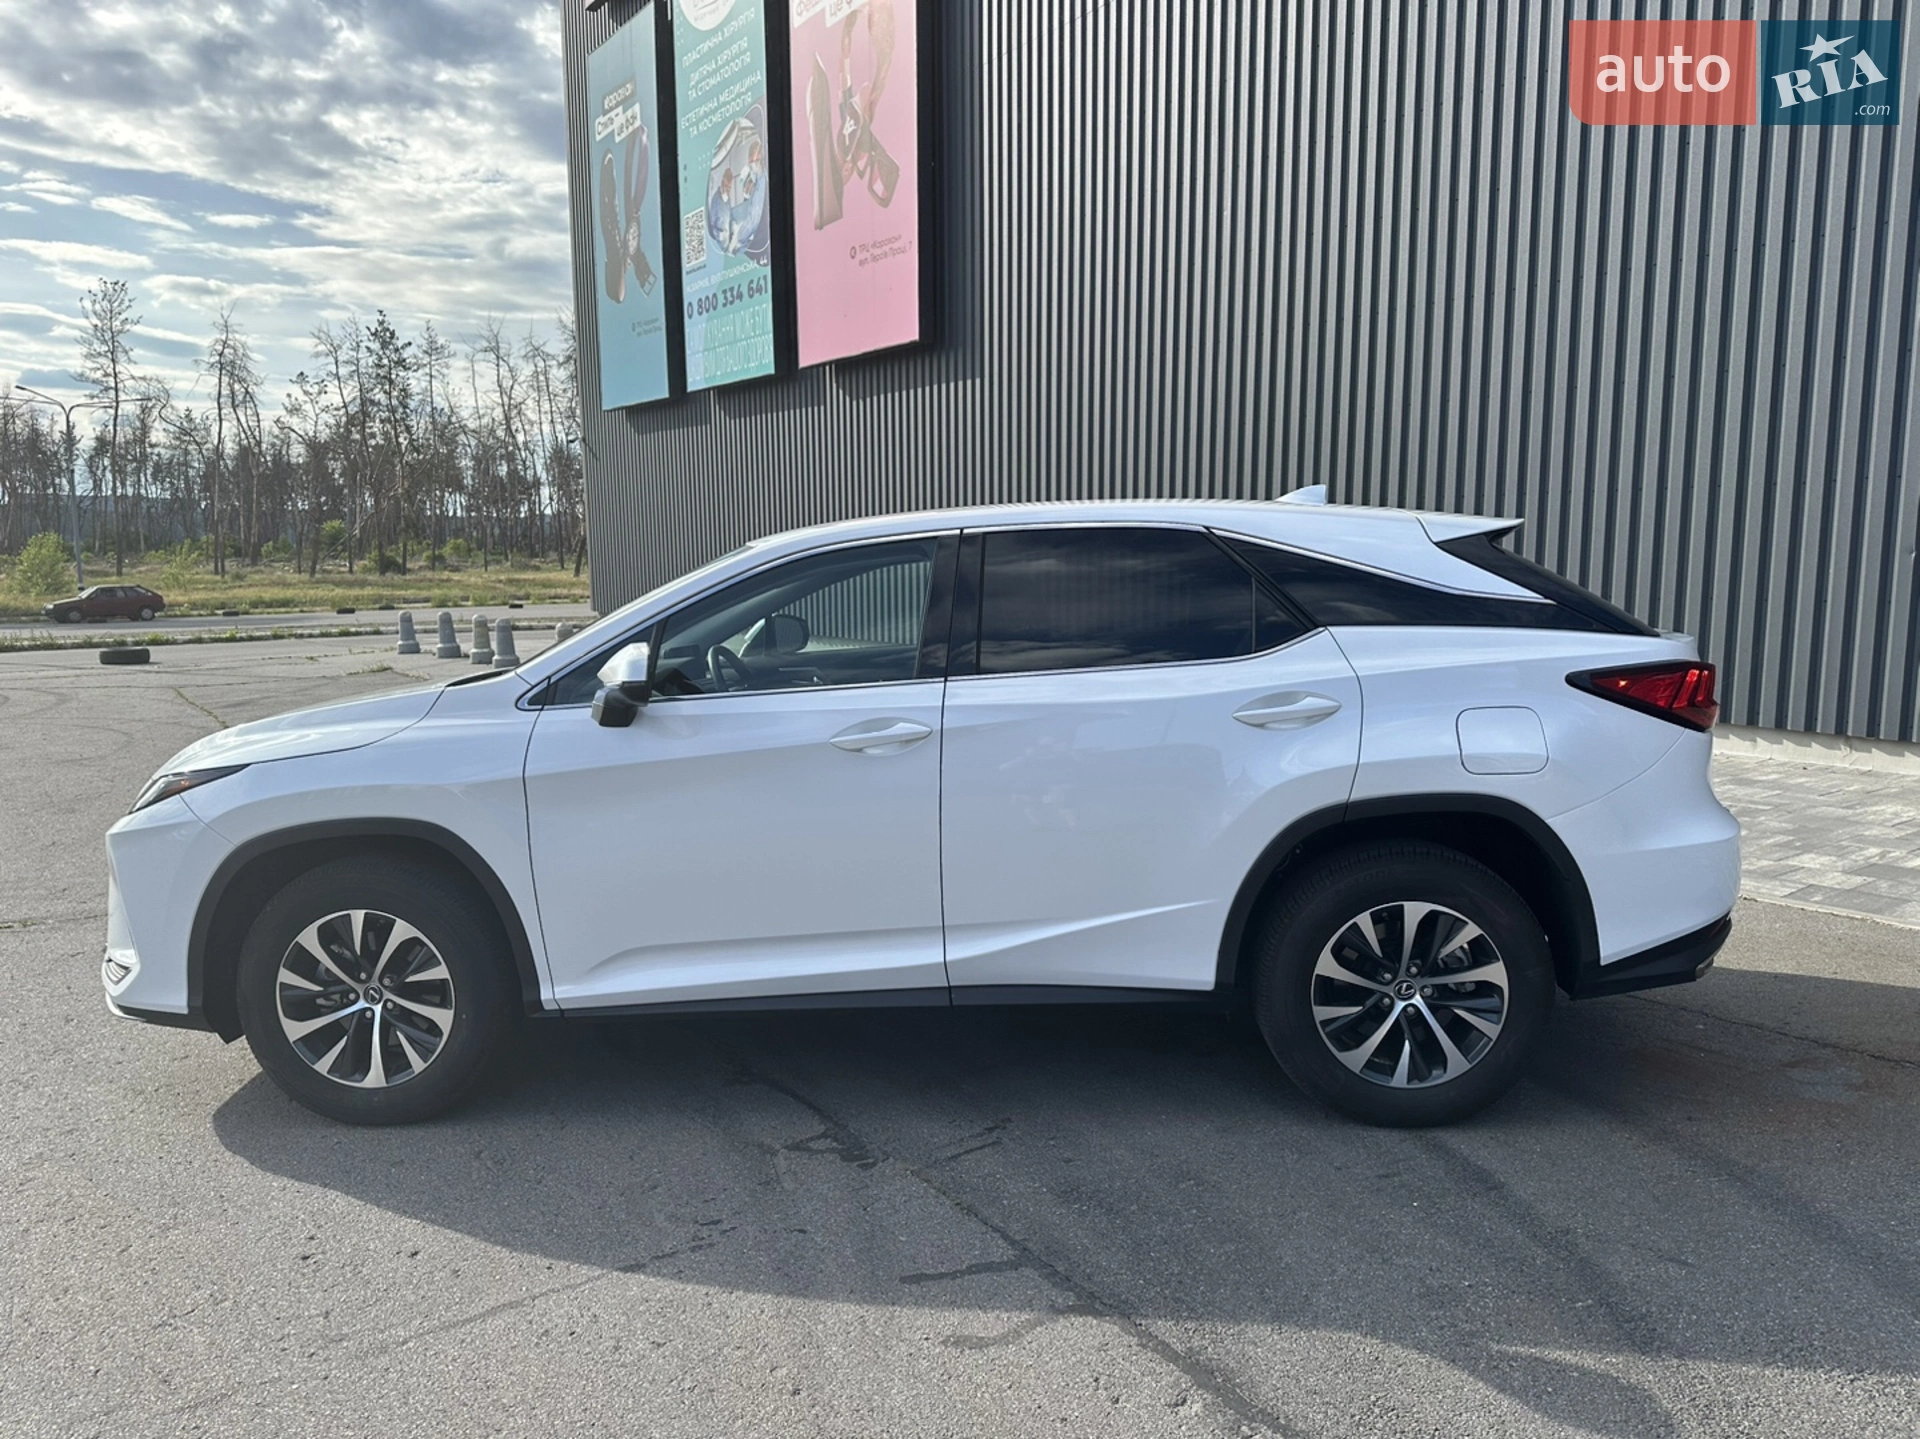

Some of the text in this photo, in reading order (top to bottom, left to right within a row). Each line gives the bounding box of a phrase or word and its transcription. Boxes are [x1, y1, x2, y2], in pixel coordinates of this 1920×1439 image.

[682, 31, 722, 69] ПЛАСТИЧНА
[723, 7, 755, 40] ХІРУРГІЯ
[689, 36, 748, 89] ДИТЯЧА ХІРУРГІЯ
[681, 70, 762, 129] ЕСТЕТИЧНА МЕДИЦИНА
[688, 51, 751, 102] ТА СТОМАТОЛОГІЯ
[689, 91, 752, 139] ТА КОСМЕТОЛОГІЯ
[759, 254, 768, 266] 44
[686, 274, 769, 320] 0 800 334 641
